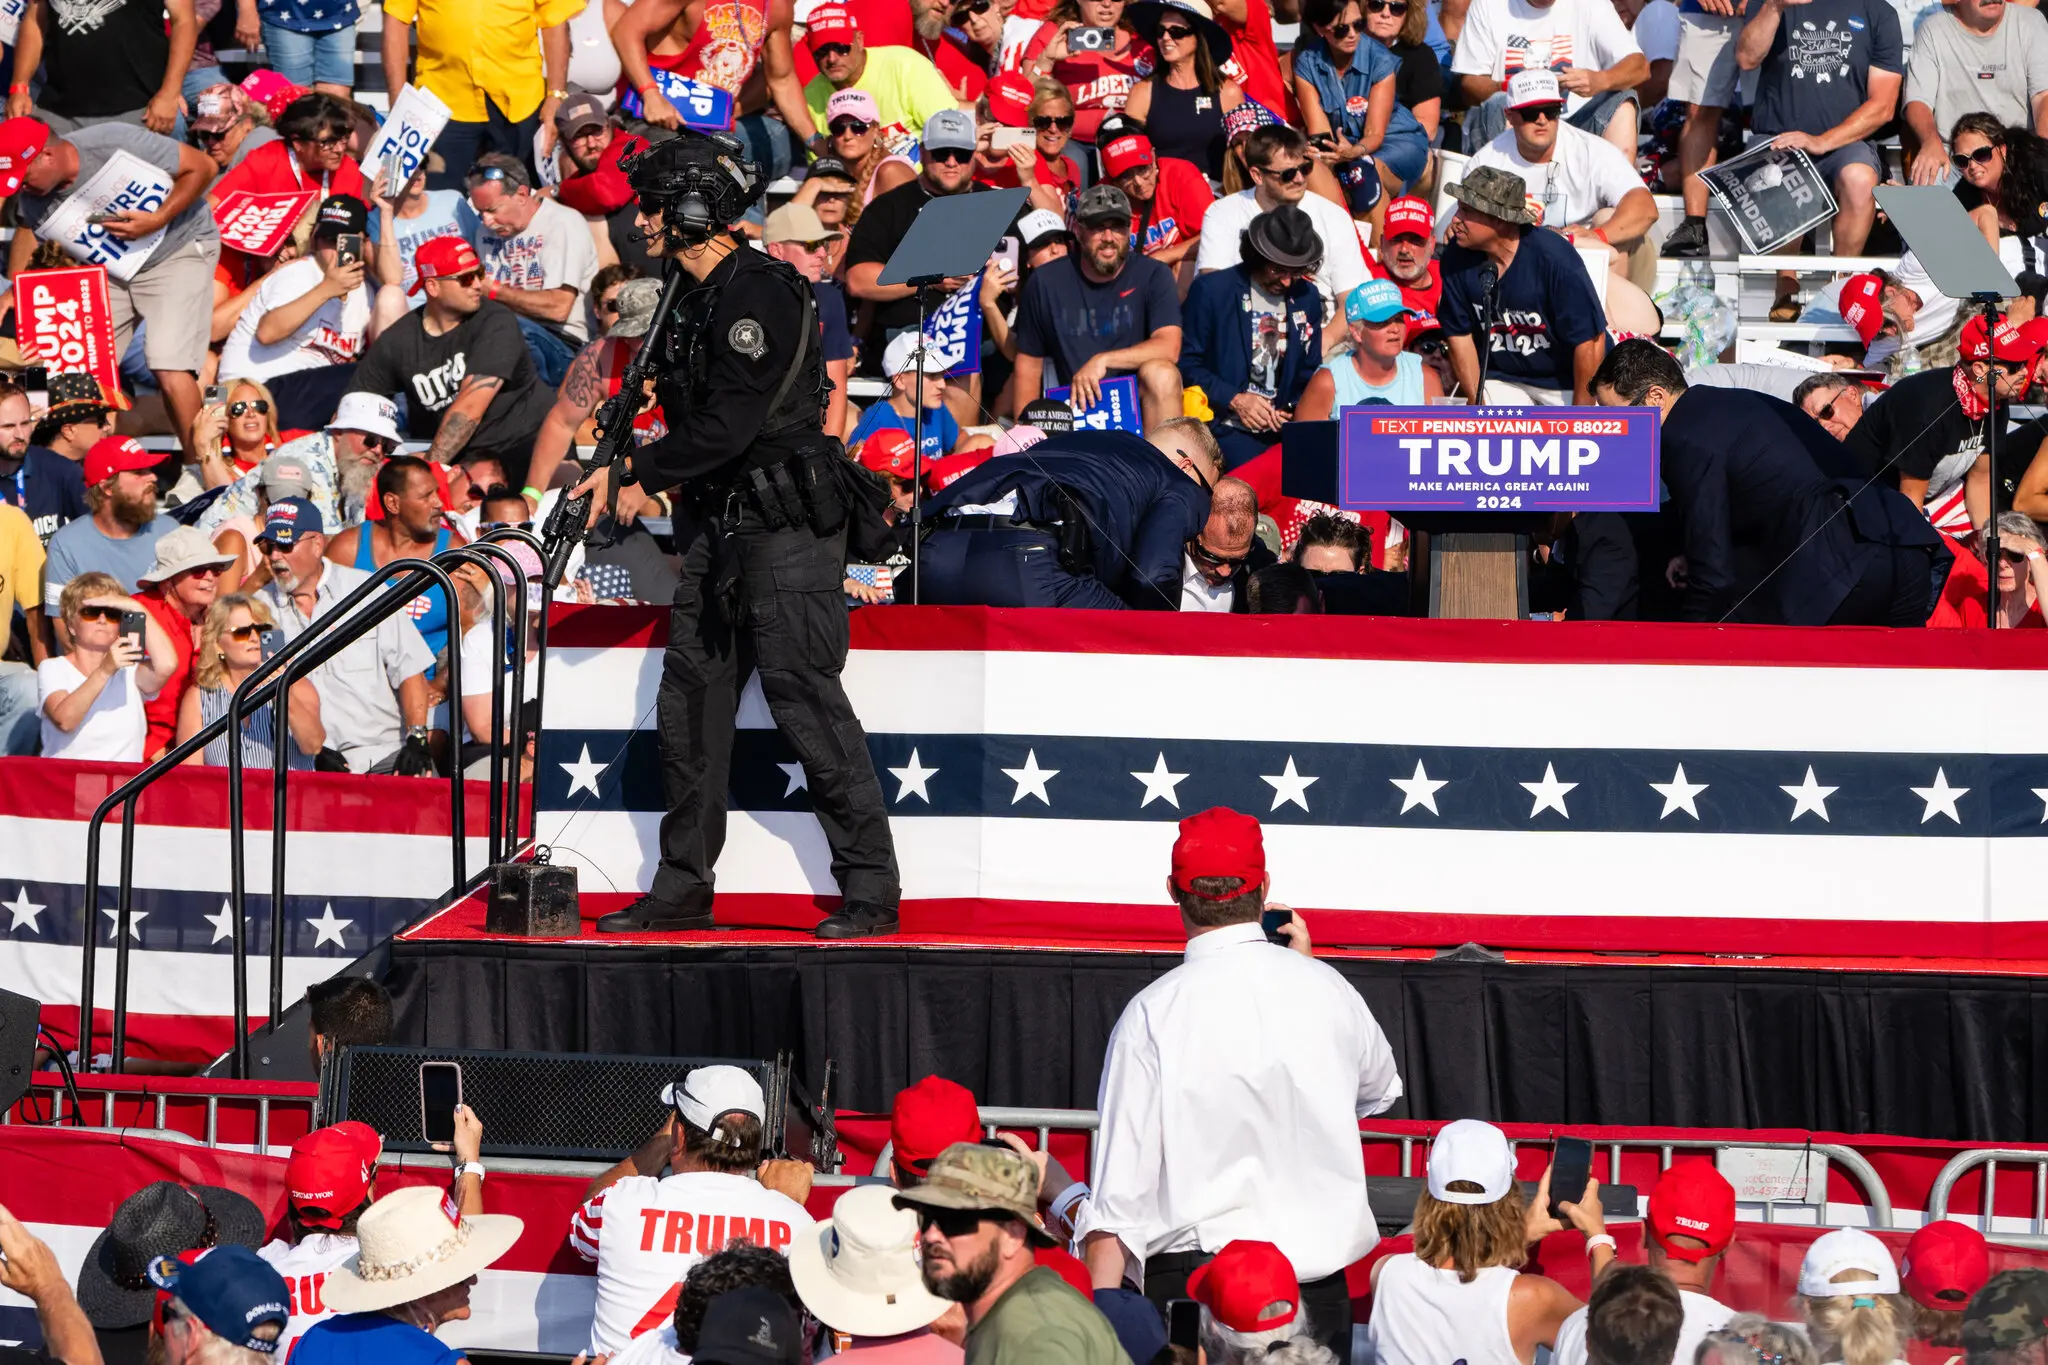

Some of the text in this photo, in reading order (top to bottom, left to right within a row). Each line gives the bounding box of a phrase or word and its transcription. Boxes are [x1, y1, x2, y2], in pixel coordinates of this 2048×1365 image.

[1807, 39, 1840, 50] Hello
[832, 94, 866, 106] TRUMP
[1770, 150, 1813, 210] EVER
[322, 208, 352, 218] TRUMP
[1388, 200, 1428, 214] MAKE AMERICA
[221, 205, 270, 241] 2024
[241, 197, 299, 249] TRUMP
[399, 223, 459, 254] RUMP
[84, 315, 93, 330] TO
[934, 294, 958, 349] 024
[947, 276, 979, 362] RUMP
[33, 285, 63, 380] RUMP
[753, 347, 765, 358] CAT
[1974, 342, 1989, 356] 45
[1109, 389, 1122, 422] 88022
[1028, 410, 1073, 420] MAKE AMERICA
[1378, 420, 1621, 434] TEXT PENNSYLVANIA TO 88022
[1399, 438, 1601, 476] TRUMP
[1409, 482, 1590, 492] MAKE AMERICA GREAT AGAIN!
[1476, 496, 1522, 509] 2024
[292, 1190, 333, 1199] TRUMP WON
[640, 1208, 791, 1254] TRUMP
[1675, 1216, 1710, 1231] TRUMP
[246, 1302, 281, 1323] DONALD
